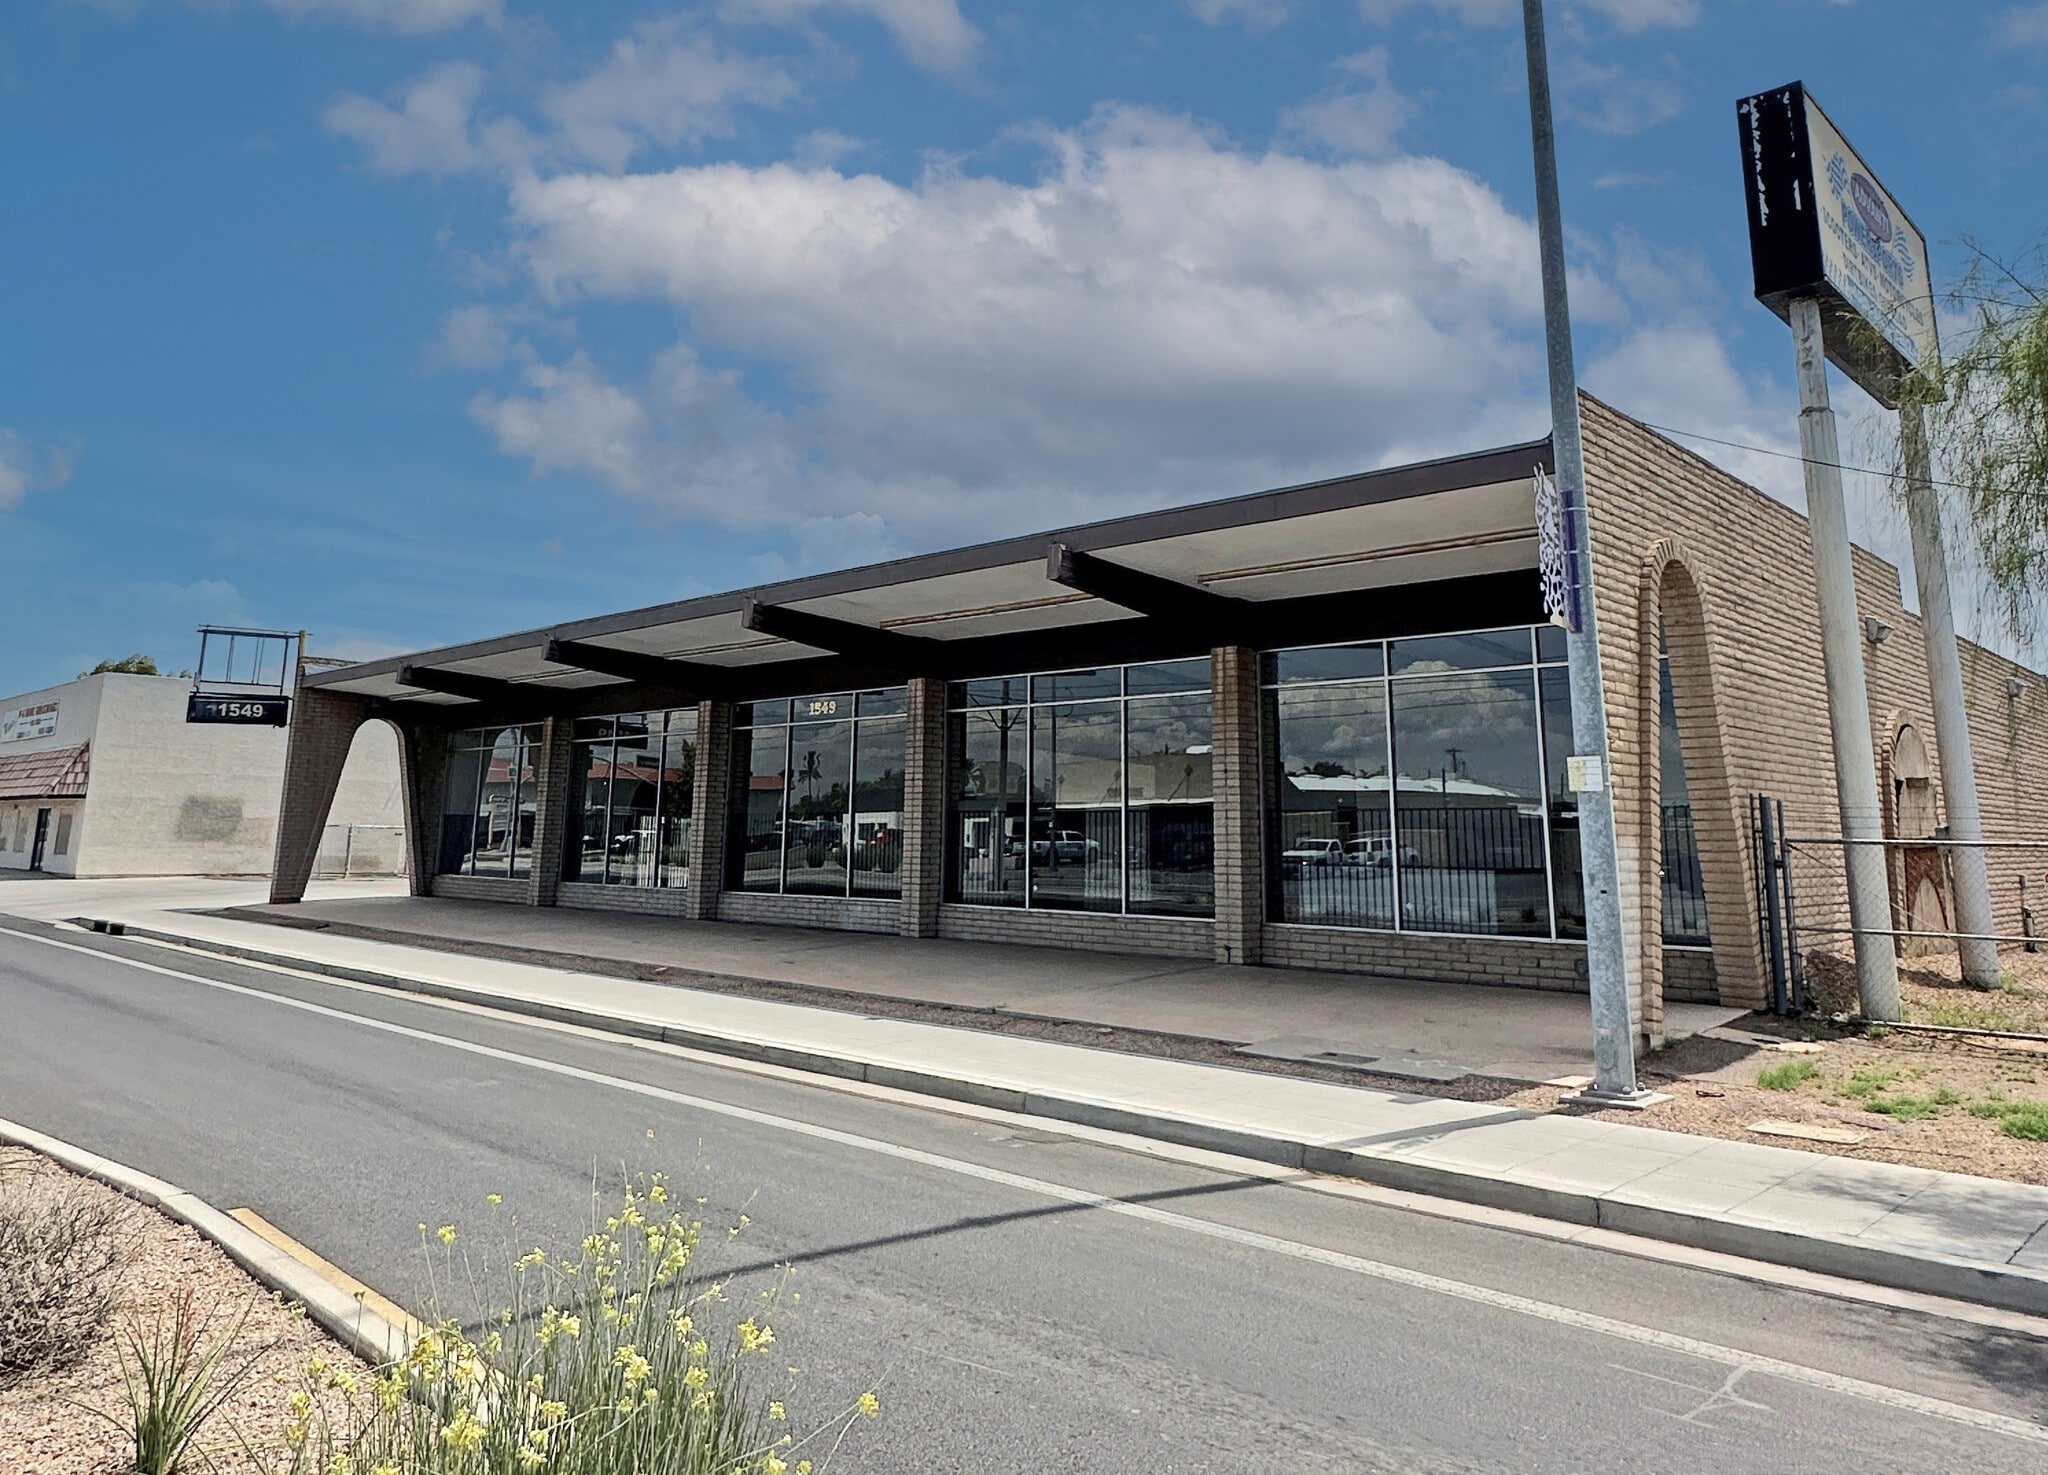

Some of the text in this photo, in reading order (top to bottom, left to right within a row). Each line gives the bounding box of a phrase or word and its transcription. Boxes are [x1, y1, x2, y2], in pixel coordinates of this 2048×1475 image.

[1841, 201, 1904, 287] POWERSPORTS
[218, 703, 263, 717] 1549
[809, 701, 836, 715] 1549
